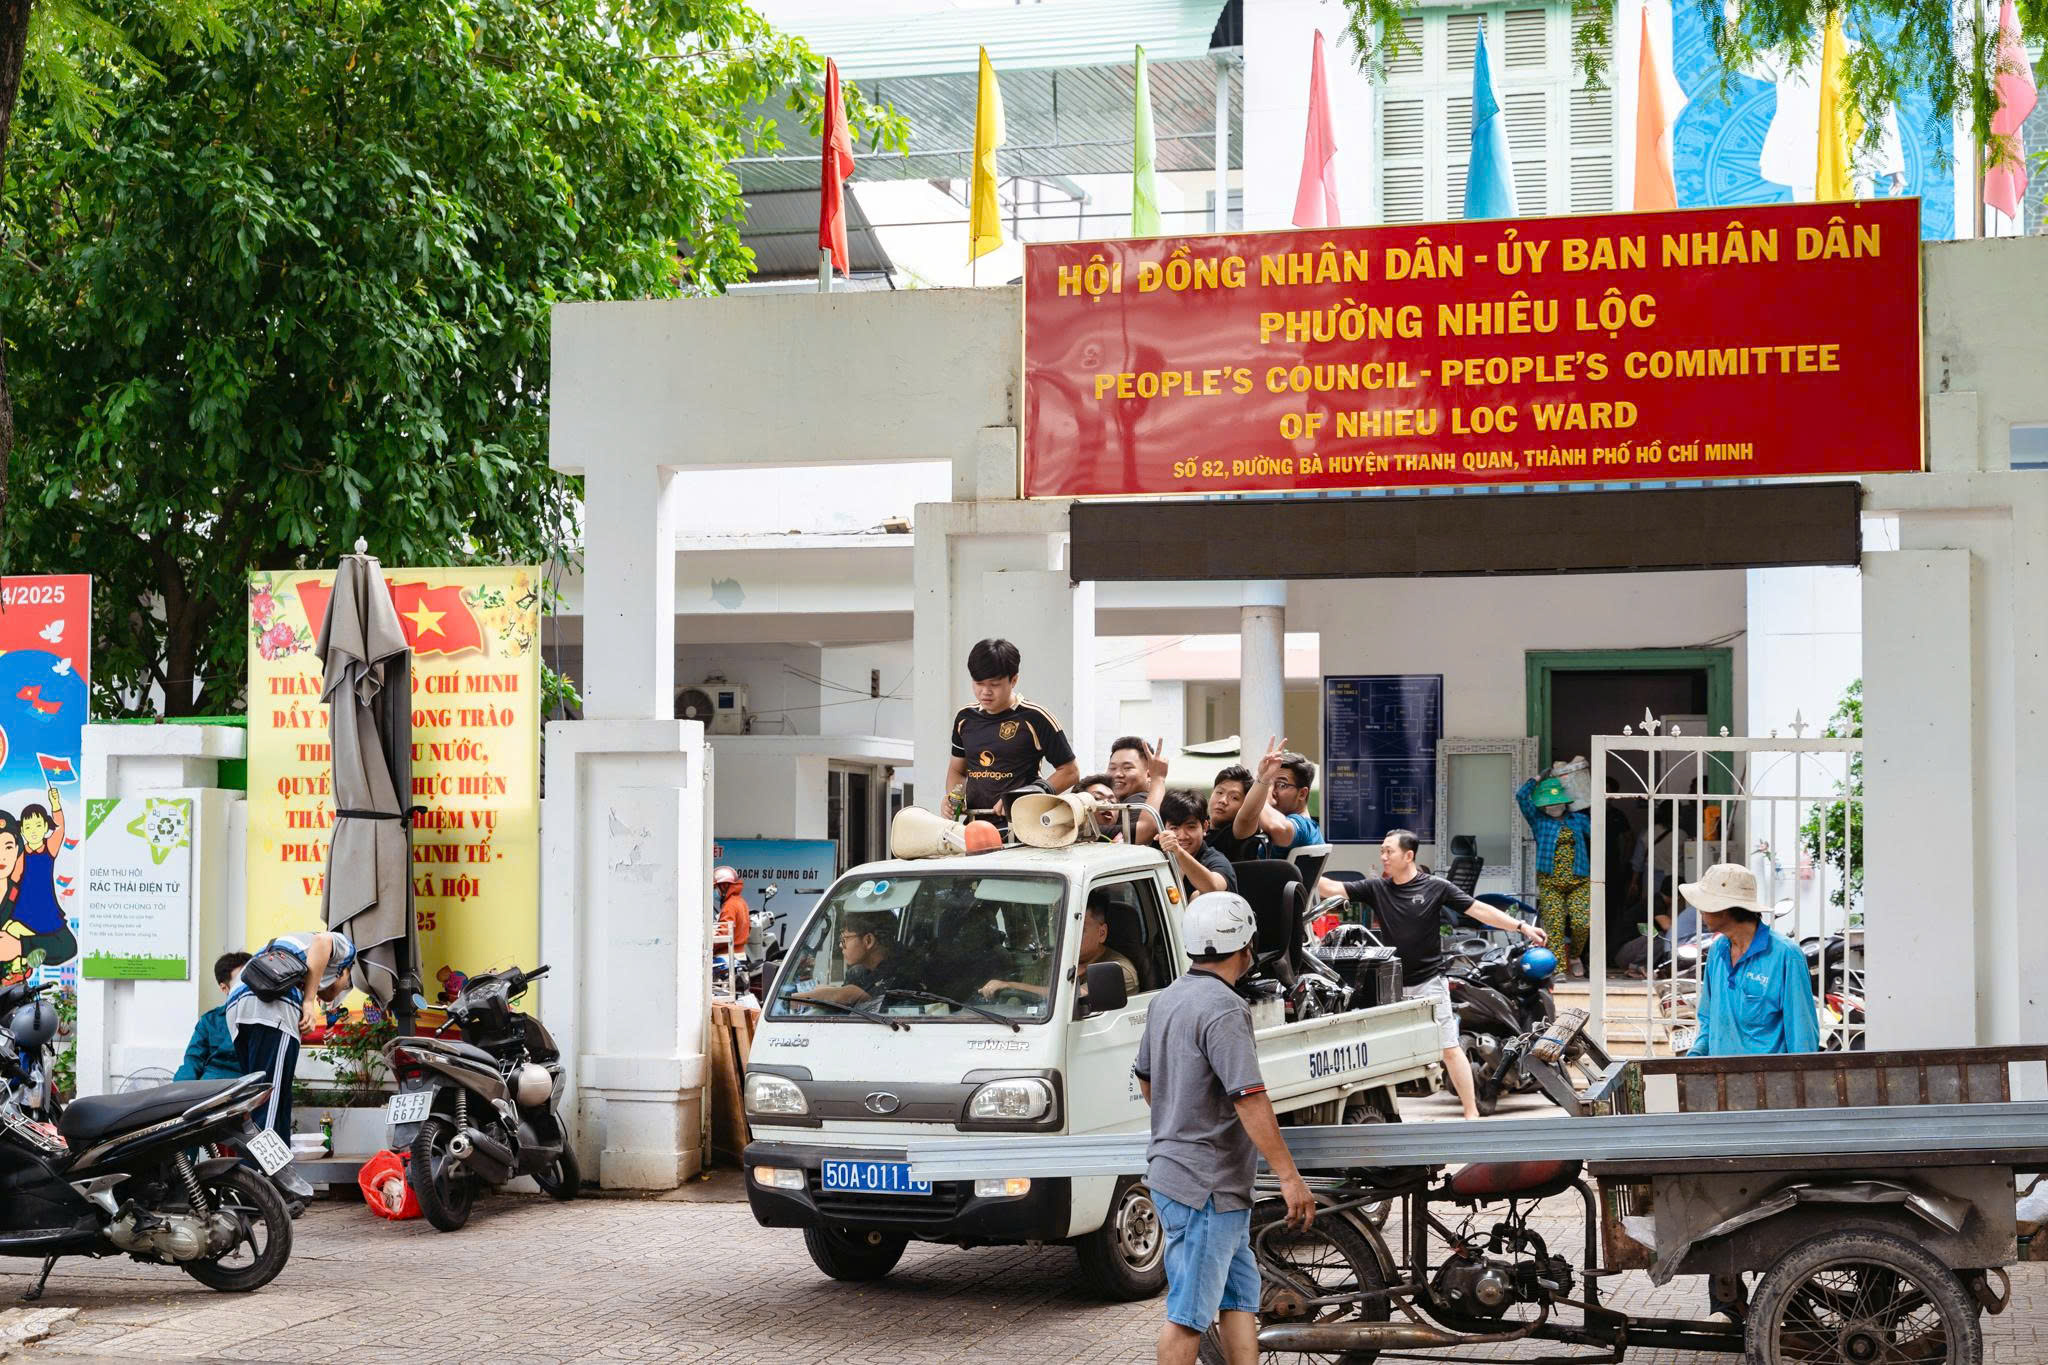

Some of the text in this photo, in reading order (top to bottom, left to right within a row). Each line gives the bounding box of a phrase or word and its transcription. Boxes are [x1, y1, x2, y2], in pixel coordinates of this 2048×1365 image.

[1058, 254, 1122, 302] HỘI
[1137, 245, 1246, 292] ĐỒNG
[1260, 242, 1369, 287] NHÂN
[1385, 237, 1464, 281] DÂN
[1496, 228, 1551, 275] ỦY
[1562, 235, 1647, 273] BAN
[1662, 221, 1778, 268] NHÂN
[1796, 216, 1881, 261] DÂN
[1259, 287, 1657, 345] PHƯỜNG NHIÊU LỘC
[1094, 366, 1253, 400] PEOPLE’S
[1441, 351, 1609, 386] PEOPLE’S
[1624, 343, 1840, 380] COMMITTEE
[1279, 401, 1638, 440] OF NHIEU LOC WARD
[1173, 439, 1753, 480] SỐ 82, ĐƯỜNG BÀ HUYỆN THANH QUAN, THÀNH PHỐ HỒ CHÍ MINH
[268, 672, 322, 695] THÀN
[425, 670, 459, 694] CHÍ
[466, 674, 519, 693] MINH
[411, 708, 451, 728] ONG
[458, 703, 514, 727] TRÀO
[429, 738, 488, 762] NƯỚC,
[278, 769, 507, 800] QUYẾ HỰC HIỆN
[413, 805, 464, 834] HIỆM
[470, 810, 497, 834] VỤ
[464, 836, 491, 863] TẾ
[111, 869, 127, 877] THU
[89, 880, 111, 892] RÁC
[113, 880, 137, 892] THẢI
[139, 881, 163, 895] ĐIỆN
[302, 872, 324, 896] VĂ
[440, 873, 480, 902] HỘI
[416, 912, 436, 931] 25
[768, 1037, 809, 1048] THACO
[966, 1039, 1030, 1051] TOWNER
[1309, 1042, 1368, 1078] 50A-011.10
[392, 1107, 424, 1121] 6677
[263, 1146, 288, 1170] 5248
